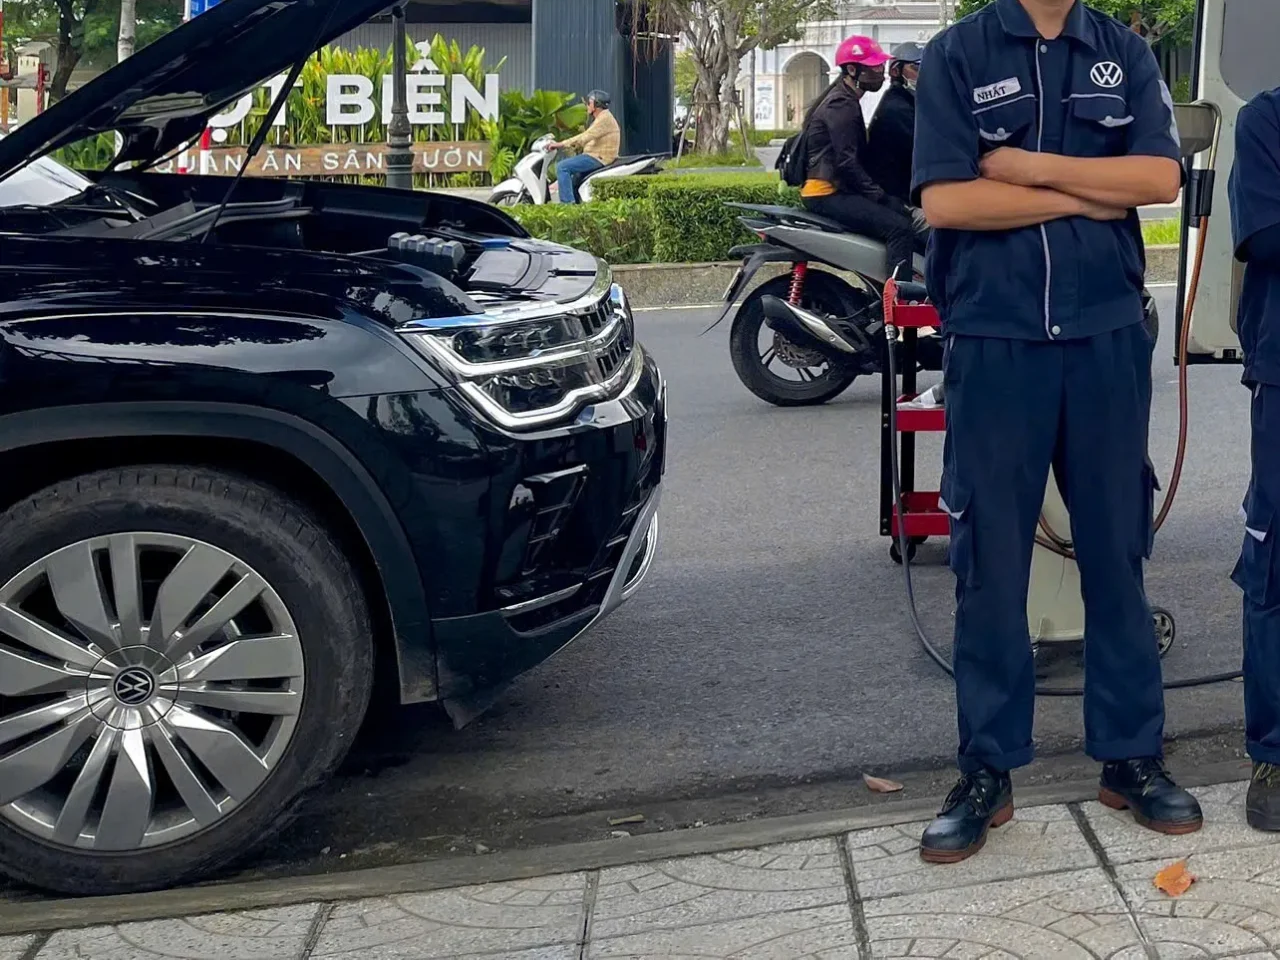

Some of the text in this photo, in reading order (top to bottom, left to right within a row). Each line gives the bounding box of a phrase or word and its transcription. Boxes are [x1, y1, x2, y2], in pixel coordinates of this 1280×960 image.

[326, 40, 500, 126] BIỂN
[976, 85, 1007, 102] NHẤT
[261, 148, 302, 171] ĂN
[323, 147, 384, 171] SÂN
[413, 144, 484, 168] ƯỜN
